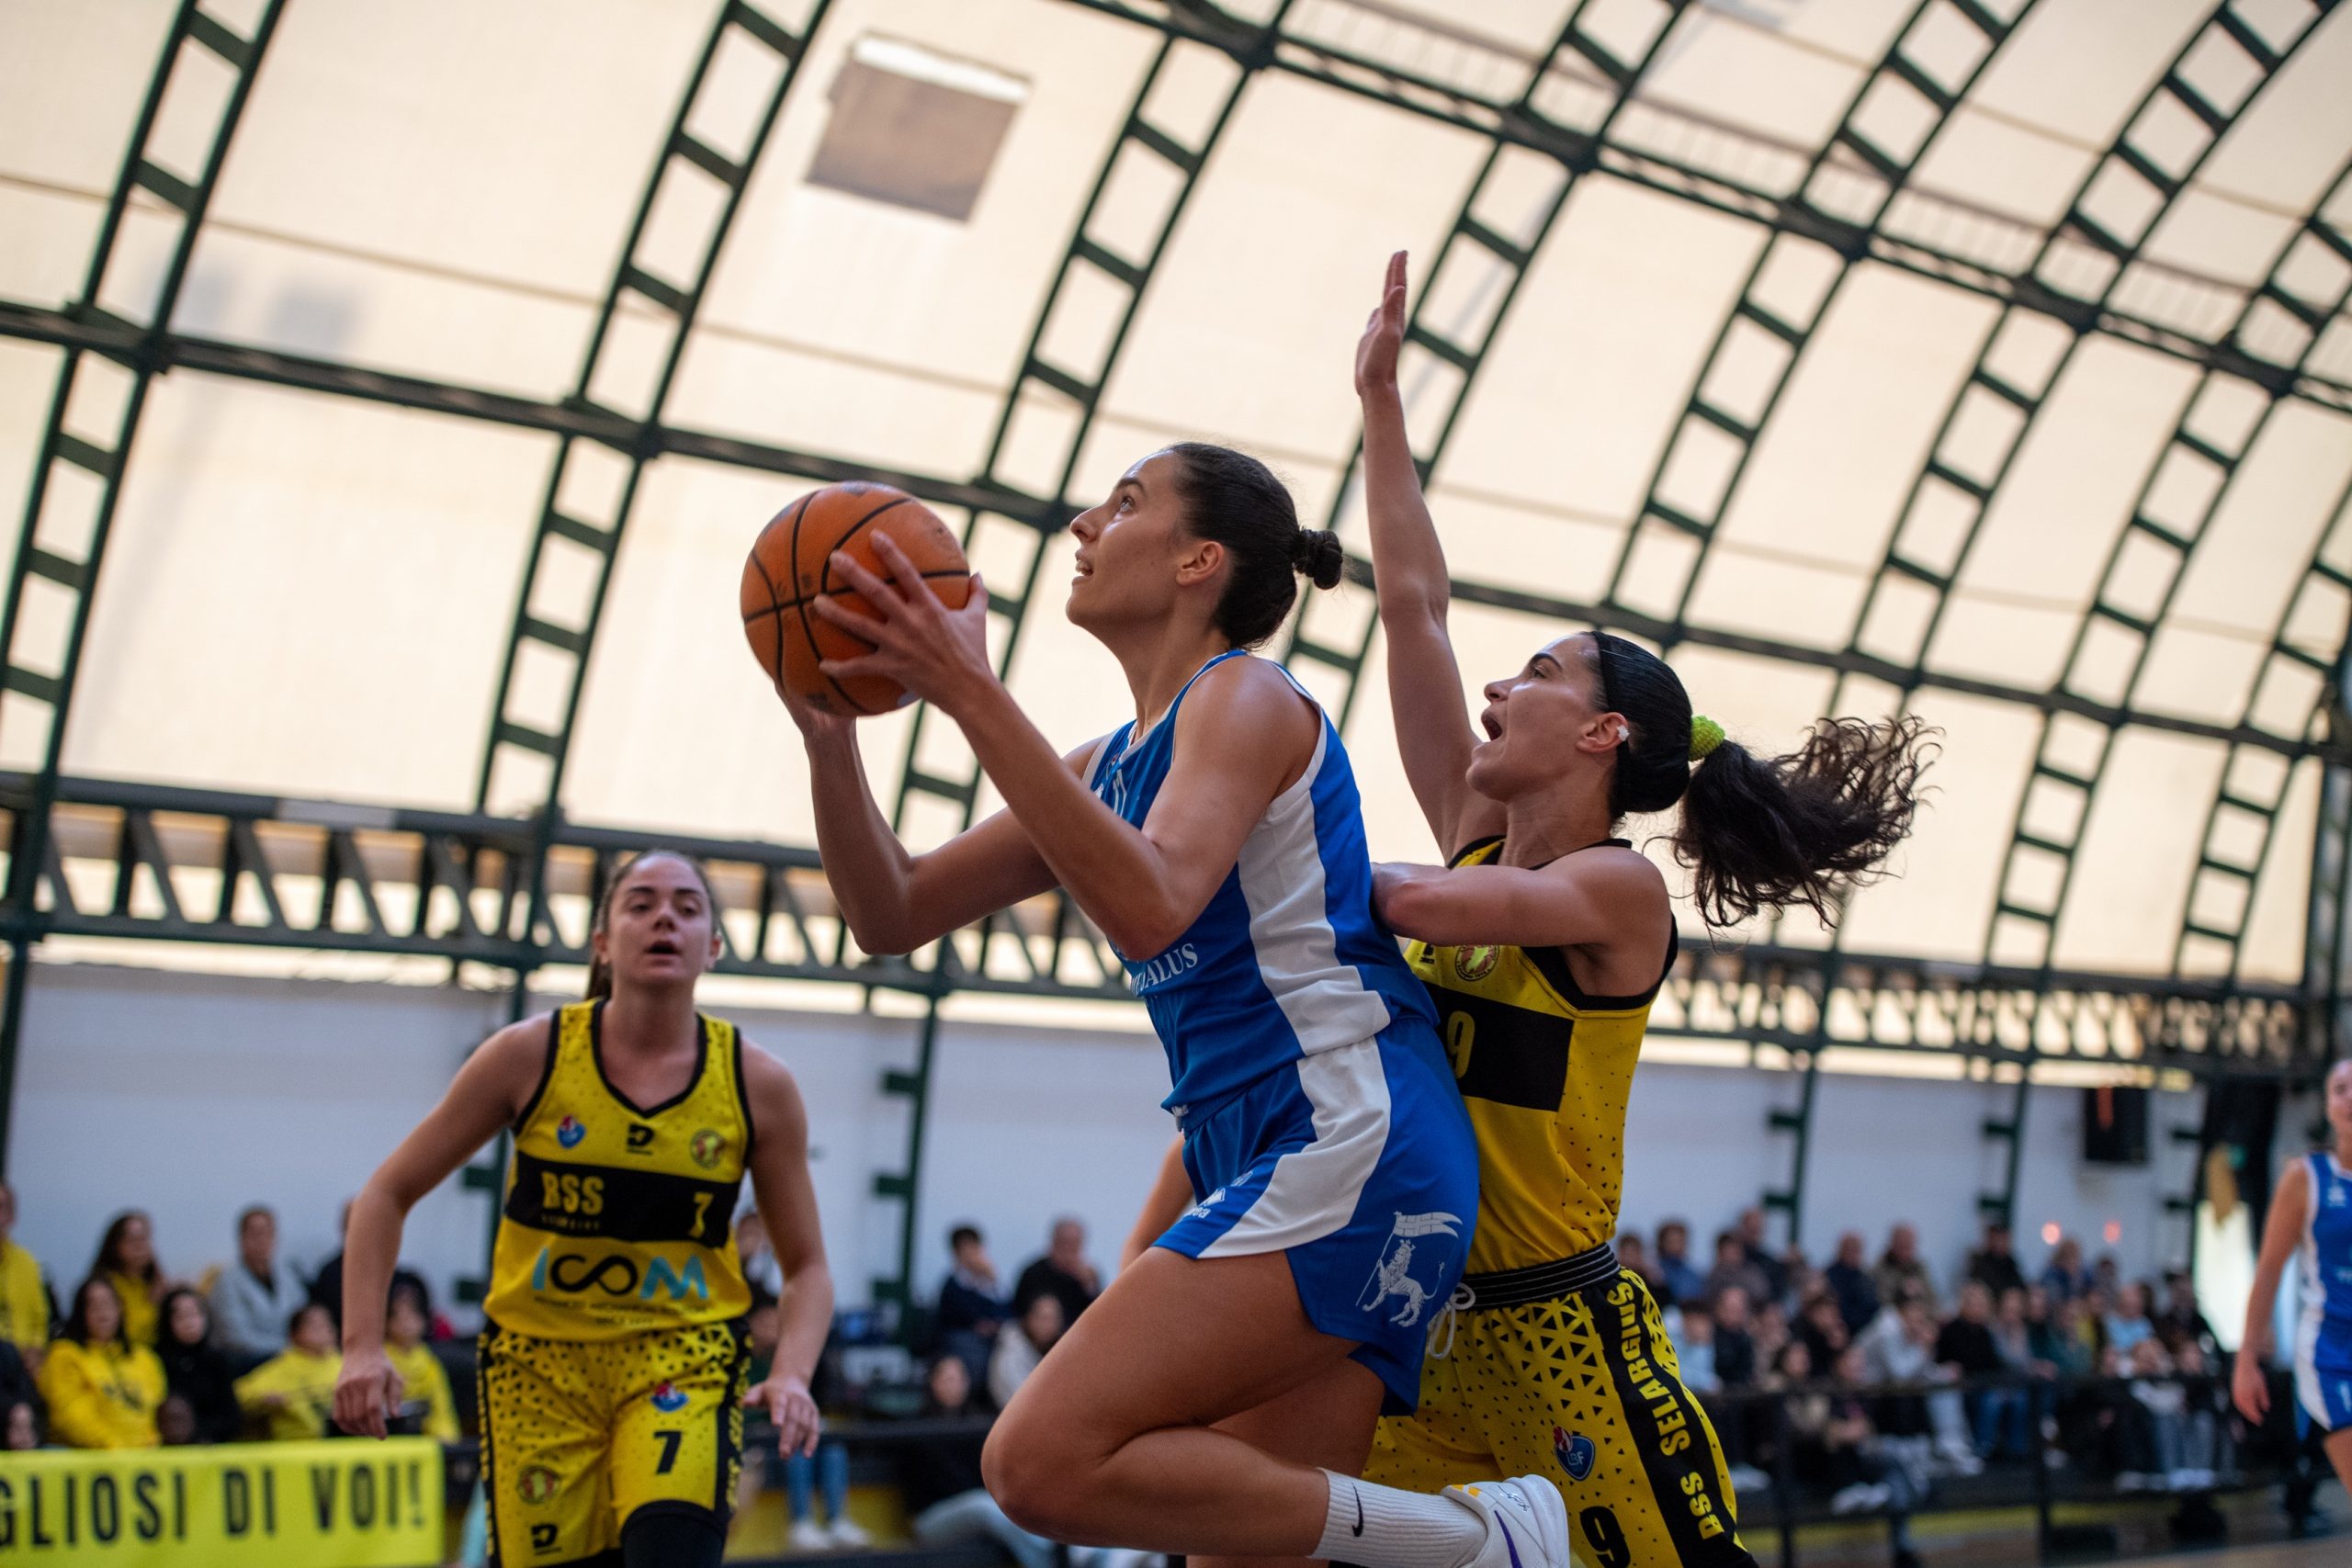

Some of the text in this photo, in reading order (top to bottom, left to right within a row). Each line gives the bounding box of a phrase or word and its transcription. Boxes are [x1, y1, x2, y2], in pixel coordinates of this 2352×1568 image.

[1447, 1011, 1476, 1078] 9
[689, 1191, 714, 1238] 7
[1607, 1281, 1691, 1456] SELARGIUS
[653, 1429, 683, 1475] 7
[225, 1467, 275, 1537] DI
[311, 1462, 424, 1532] VOI!
[1579, 1505, 1632, 1568] 9
